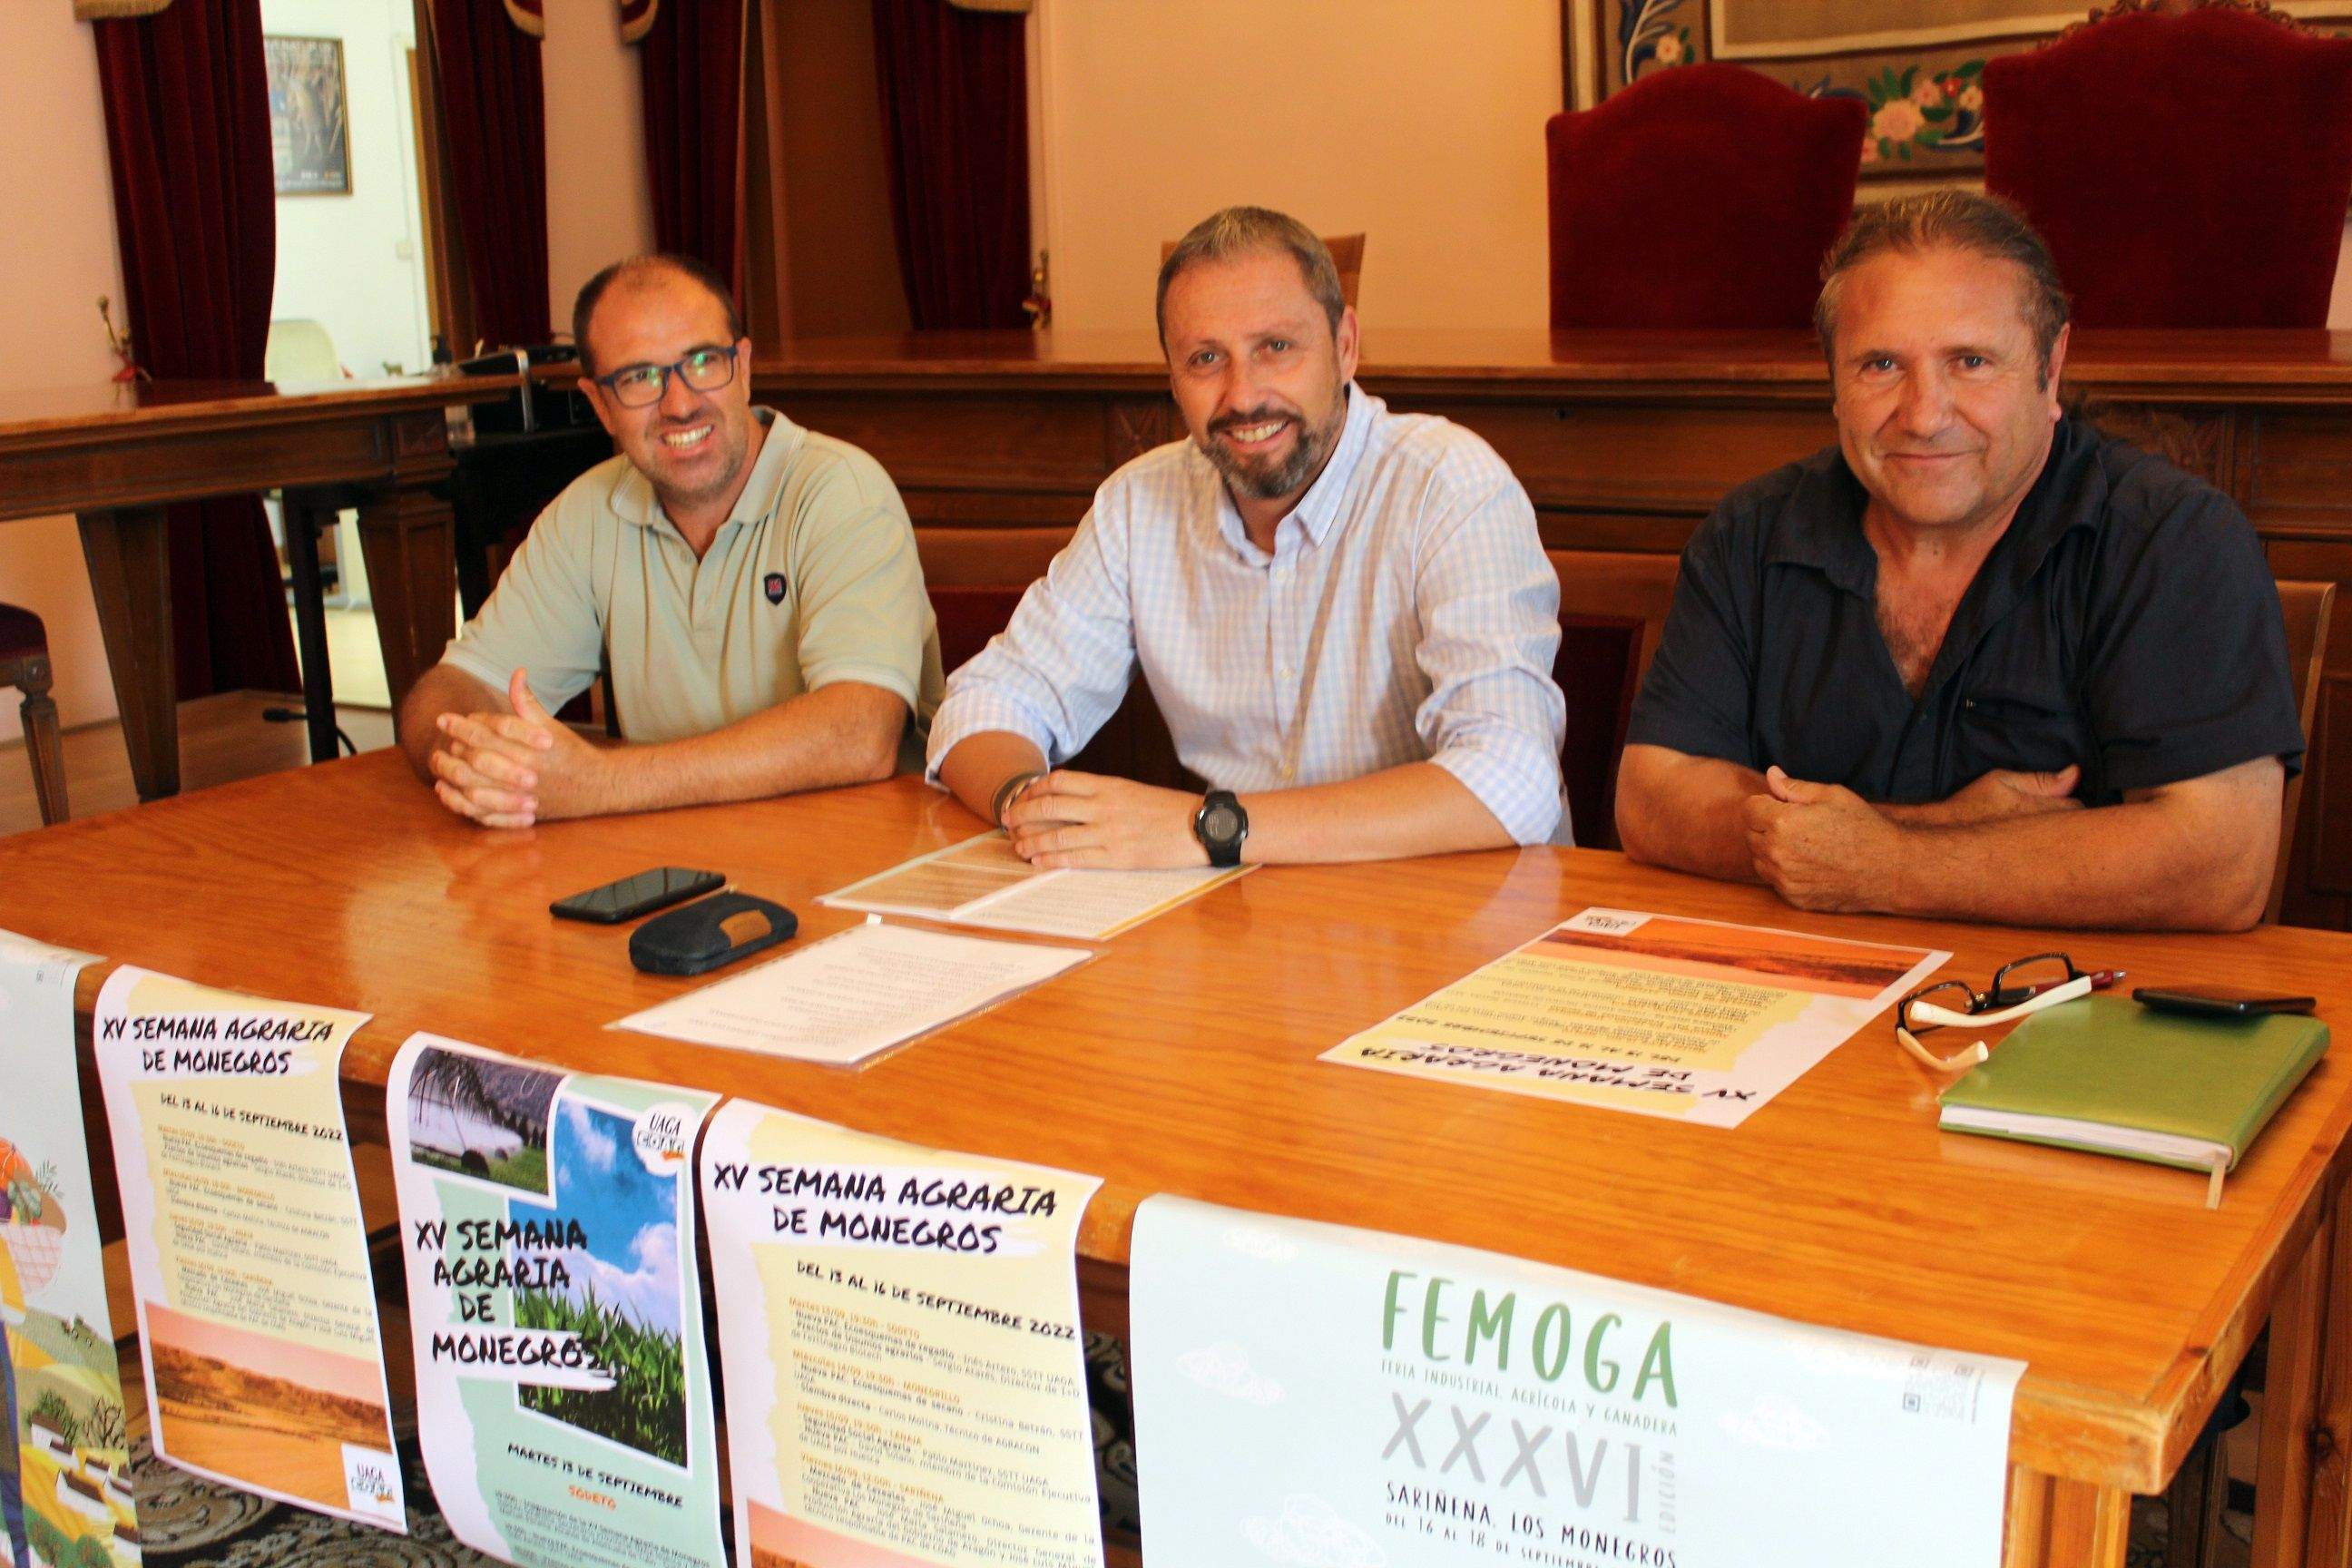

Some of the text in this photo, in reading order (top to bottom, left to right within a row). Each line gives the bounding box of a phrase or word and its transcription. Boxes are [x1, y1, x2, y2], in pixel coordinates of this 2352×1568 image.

[103, 1016, 336, 1043] XV SEMANA AGRARIA
[142, 1049, 292, 1074] DE MONEGROS
[1361, 1047, 1757, 1101] XV SEMANA AGRARIA
[1419, 1044, 1692, 1081] DE MONEGROS
[239, 1108, 309, 1134] SEPTIEMBRE
[650, 1112, 681, 1136] UAGA
[713, 1162, 1057, 1218] XV SEMANA AGRARIA
[415, 1218, 587, 1251] XV SEMANA
[772, 1205, 1003, 1254] DE MONEGROS
[434, 1255, 570, 1289] AGRARIA
[459, 1291, 495, 1322] DE
[796, 1259, 1074, 1339] DEL 13 AL 16 DE SEPTIEMBRE 2022
[432, 1331, 601, 1367] MONEGROS
[1382, 1269, 1678, 1409] FEMOGA
[1381, 1358, 1416, 1379] FERIA
[1586, 1403, 1595, 1418] Y
[1604, 1406, 1677, 1437] GANADERA
[507, 1443, 558, 1468] MARTES
[598, 1471, 683, 1508] SEPTIEMBRE
[1381, 1391, 1642, 1523] XXXVI
[1386, 1512, 1406, 1529] DEL
[1419, 1517, 1433, 1534] 16
[1444, 1524, 1458, 1541] AL
[1470, 1530, 1485, 1548] 18
[1496, 1541, 1510, 1555] DE
[1512, 1511, 1544, 1539] LOS
[1562, 1524, 1677, 1568] MONEGROS
